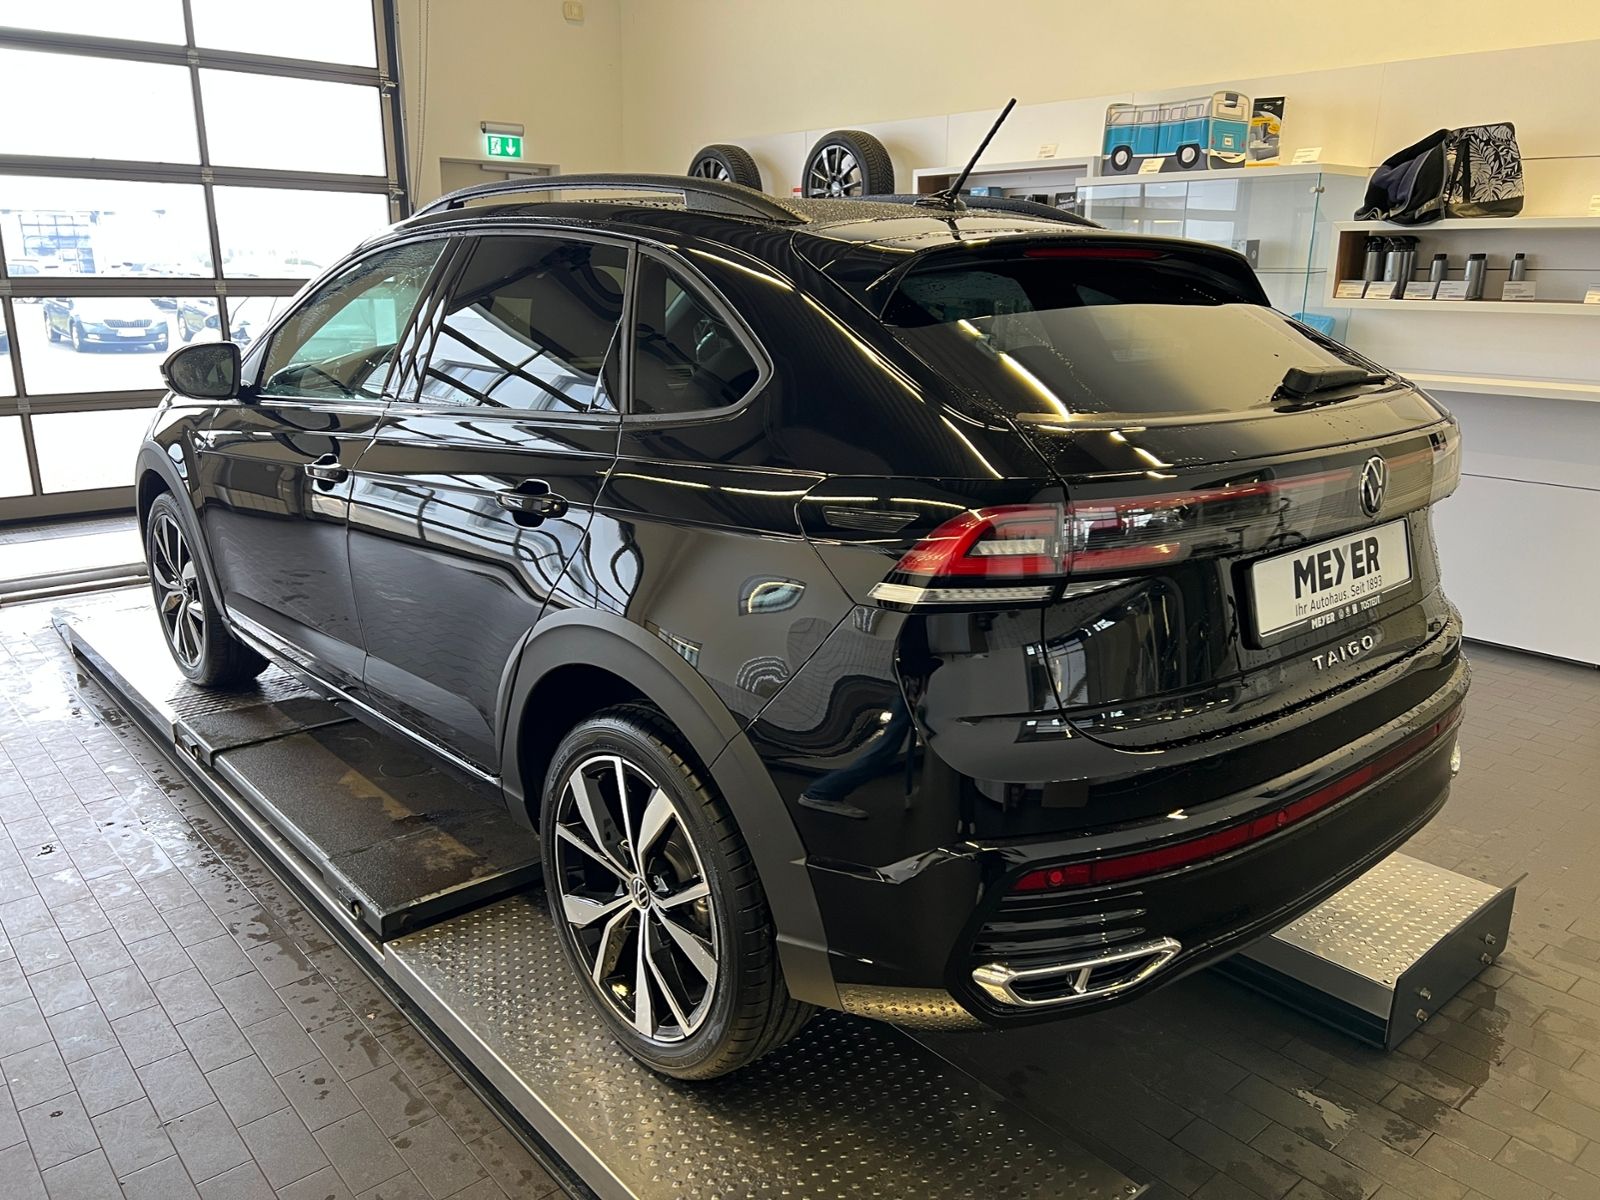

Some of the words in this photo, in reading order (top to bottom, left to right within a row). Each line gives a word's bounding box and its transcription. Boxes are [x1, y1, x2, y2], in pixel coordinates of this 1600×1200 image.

[1293, 536, 1380, 599] MEYER
[1295, 603, 1308, 616] Ihr
[1310, 590, 1350, 612] Autohaus.
[1350, 581, 1365, 597] Seit
[1366, 574, 1382, 590] 1893
[1311, 612, 1335, 630] MEYER
[1311, 635, 1374, 670] TAIGO
